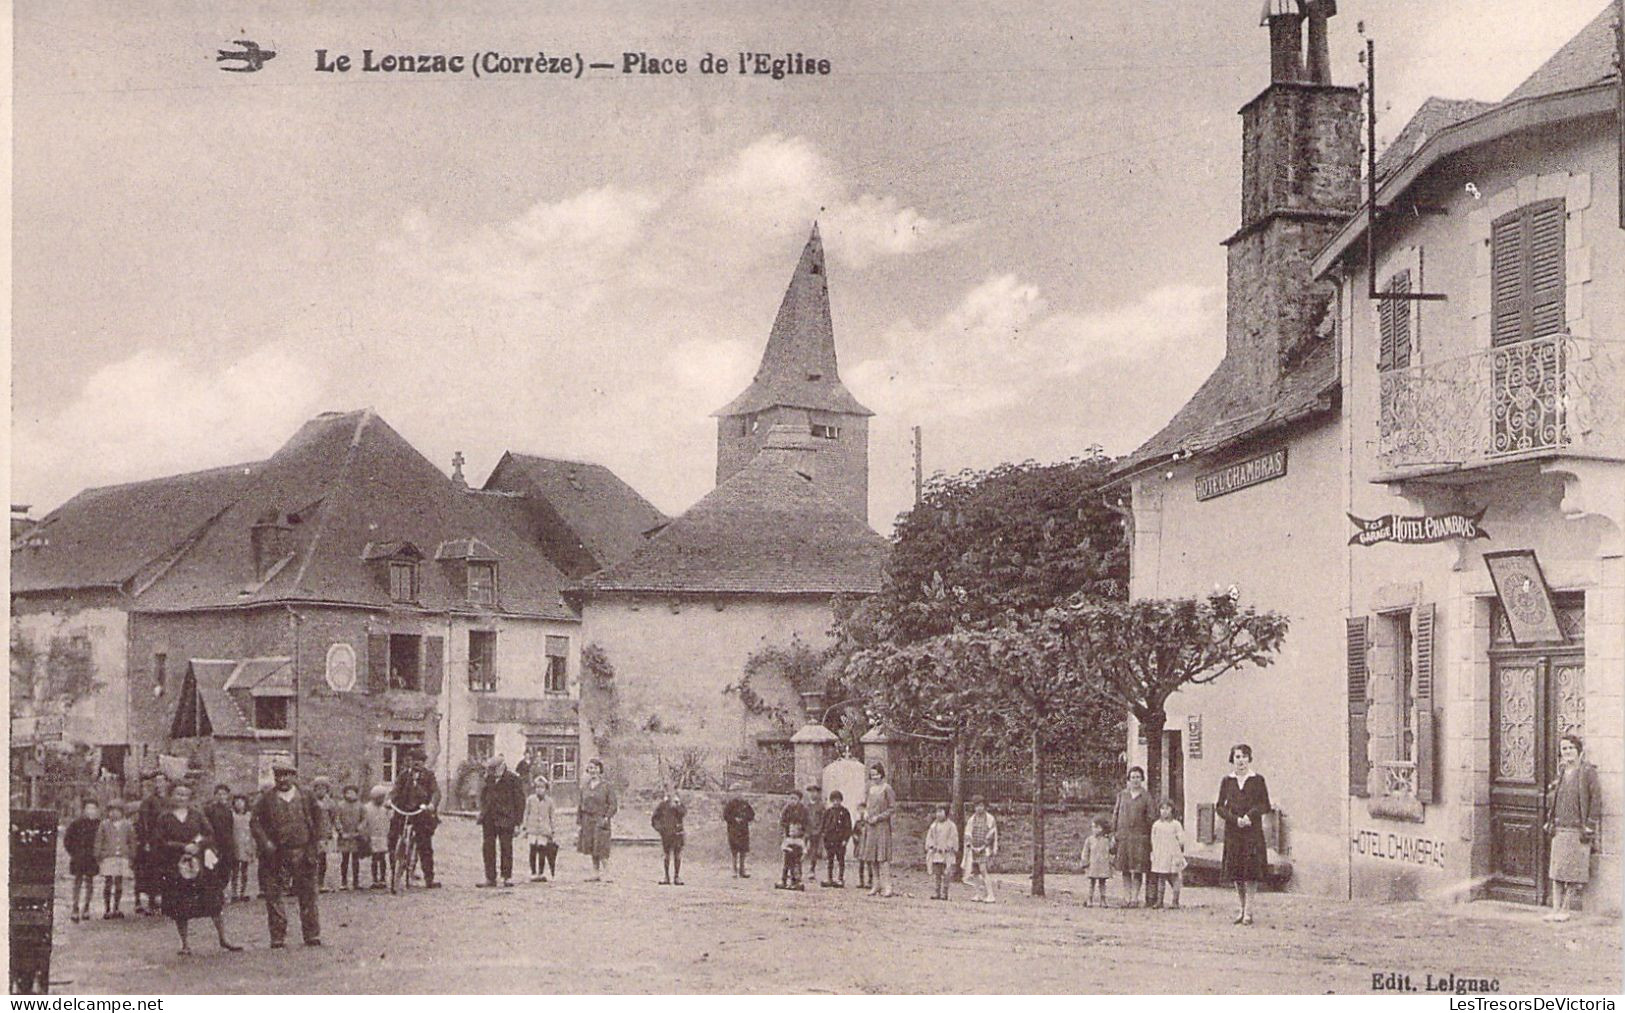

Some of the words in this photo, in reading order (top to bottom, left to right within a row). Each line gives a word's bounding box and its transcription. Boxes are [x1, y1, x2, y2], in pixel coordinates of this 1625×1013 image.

[1226, 452, 1282, 488] CHAMBRAS
[1359, 526, 1391, 544] GARAGE
[1390, 515, 1425, 542] HOTEL
[1424, 515, 1476, 539] CHAMBRAS
[1351, 829, 1385, 858] HOTEL
[1388, 833, 1445, 869] CHAMBRAS
